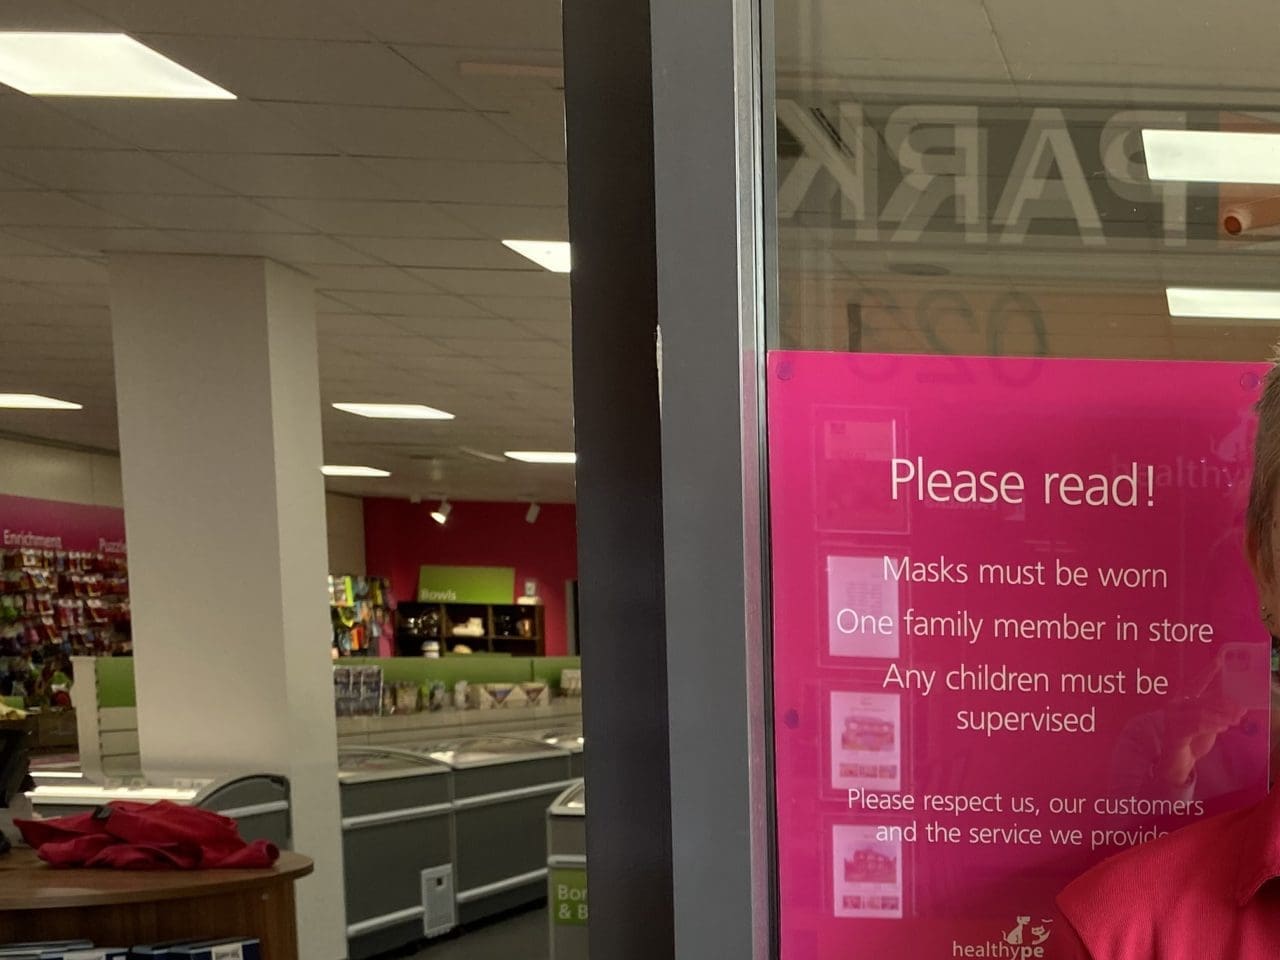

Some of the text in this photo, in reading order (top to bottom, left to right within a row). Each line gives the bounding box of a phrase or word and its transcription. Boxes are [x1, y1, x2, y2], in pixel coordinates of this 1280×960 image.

[891, 456, 1154, 507] Please read!
[883, 555, 1168, 588] Masks must be worn
[836, 608, 1214, 644] One family member in store
[882, 663, 1169, 696] Any children must be
[956, 707, 1096, 736] supervised
[848, 787, 1204, 816] Please respect us, our customers
[875, 820, 917, 842] and
[925, 821, 961, 843] the
[969, 823, 1042, 844] service
[1050, 828, 1083, 845] we
